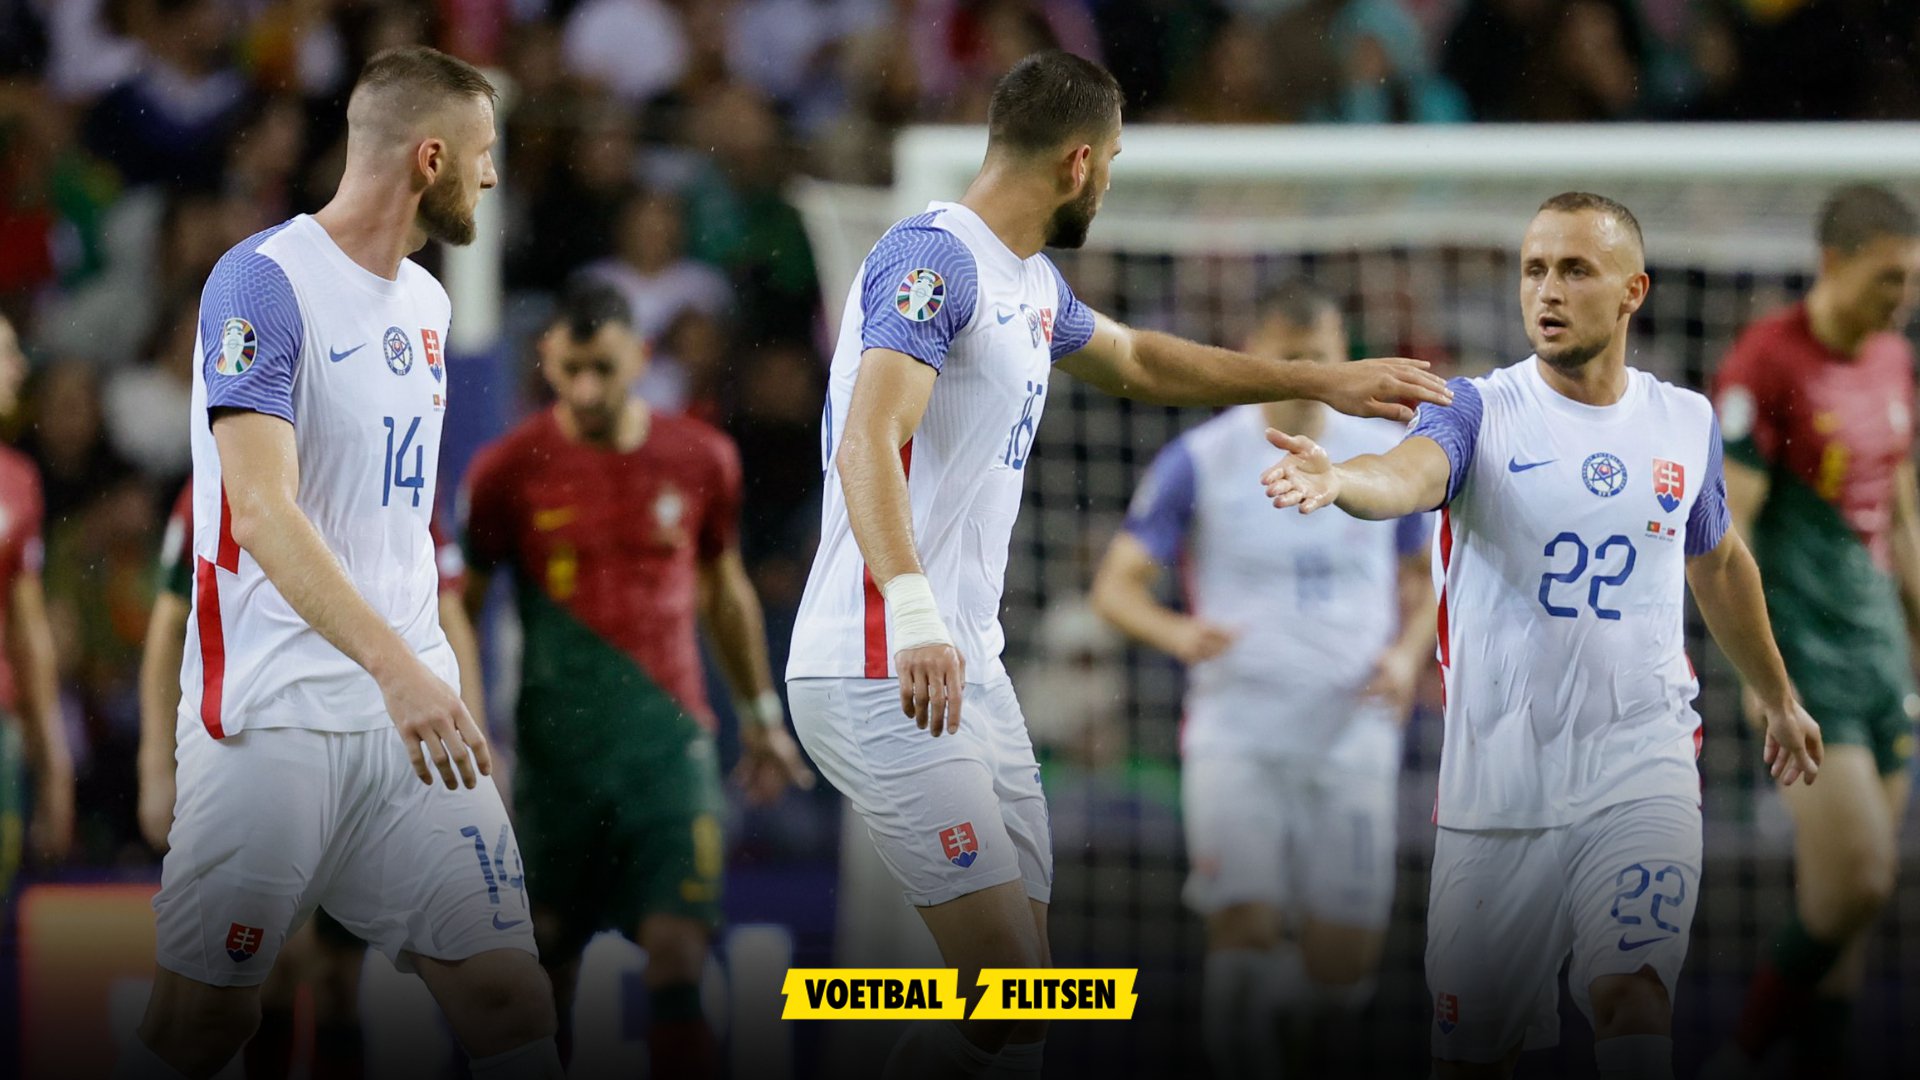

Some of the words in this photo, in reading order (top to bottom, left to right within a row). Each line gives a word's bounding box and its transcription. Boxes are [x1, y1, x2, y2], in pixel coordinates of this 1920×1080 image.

[382, 416, 425, 506] 14
[1538, 531, 1637, 621] 22
[460, 824, 526, 909] 14
[1611, 863, 1685, 934] 22
